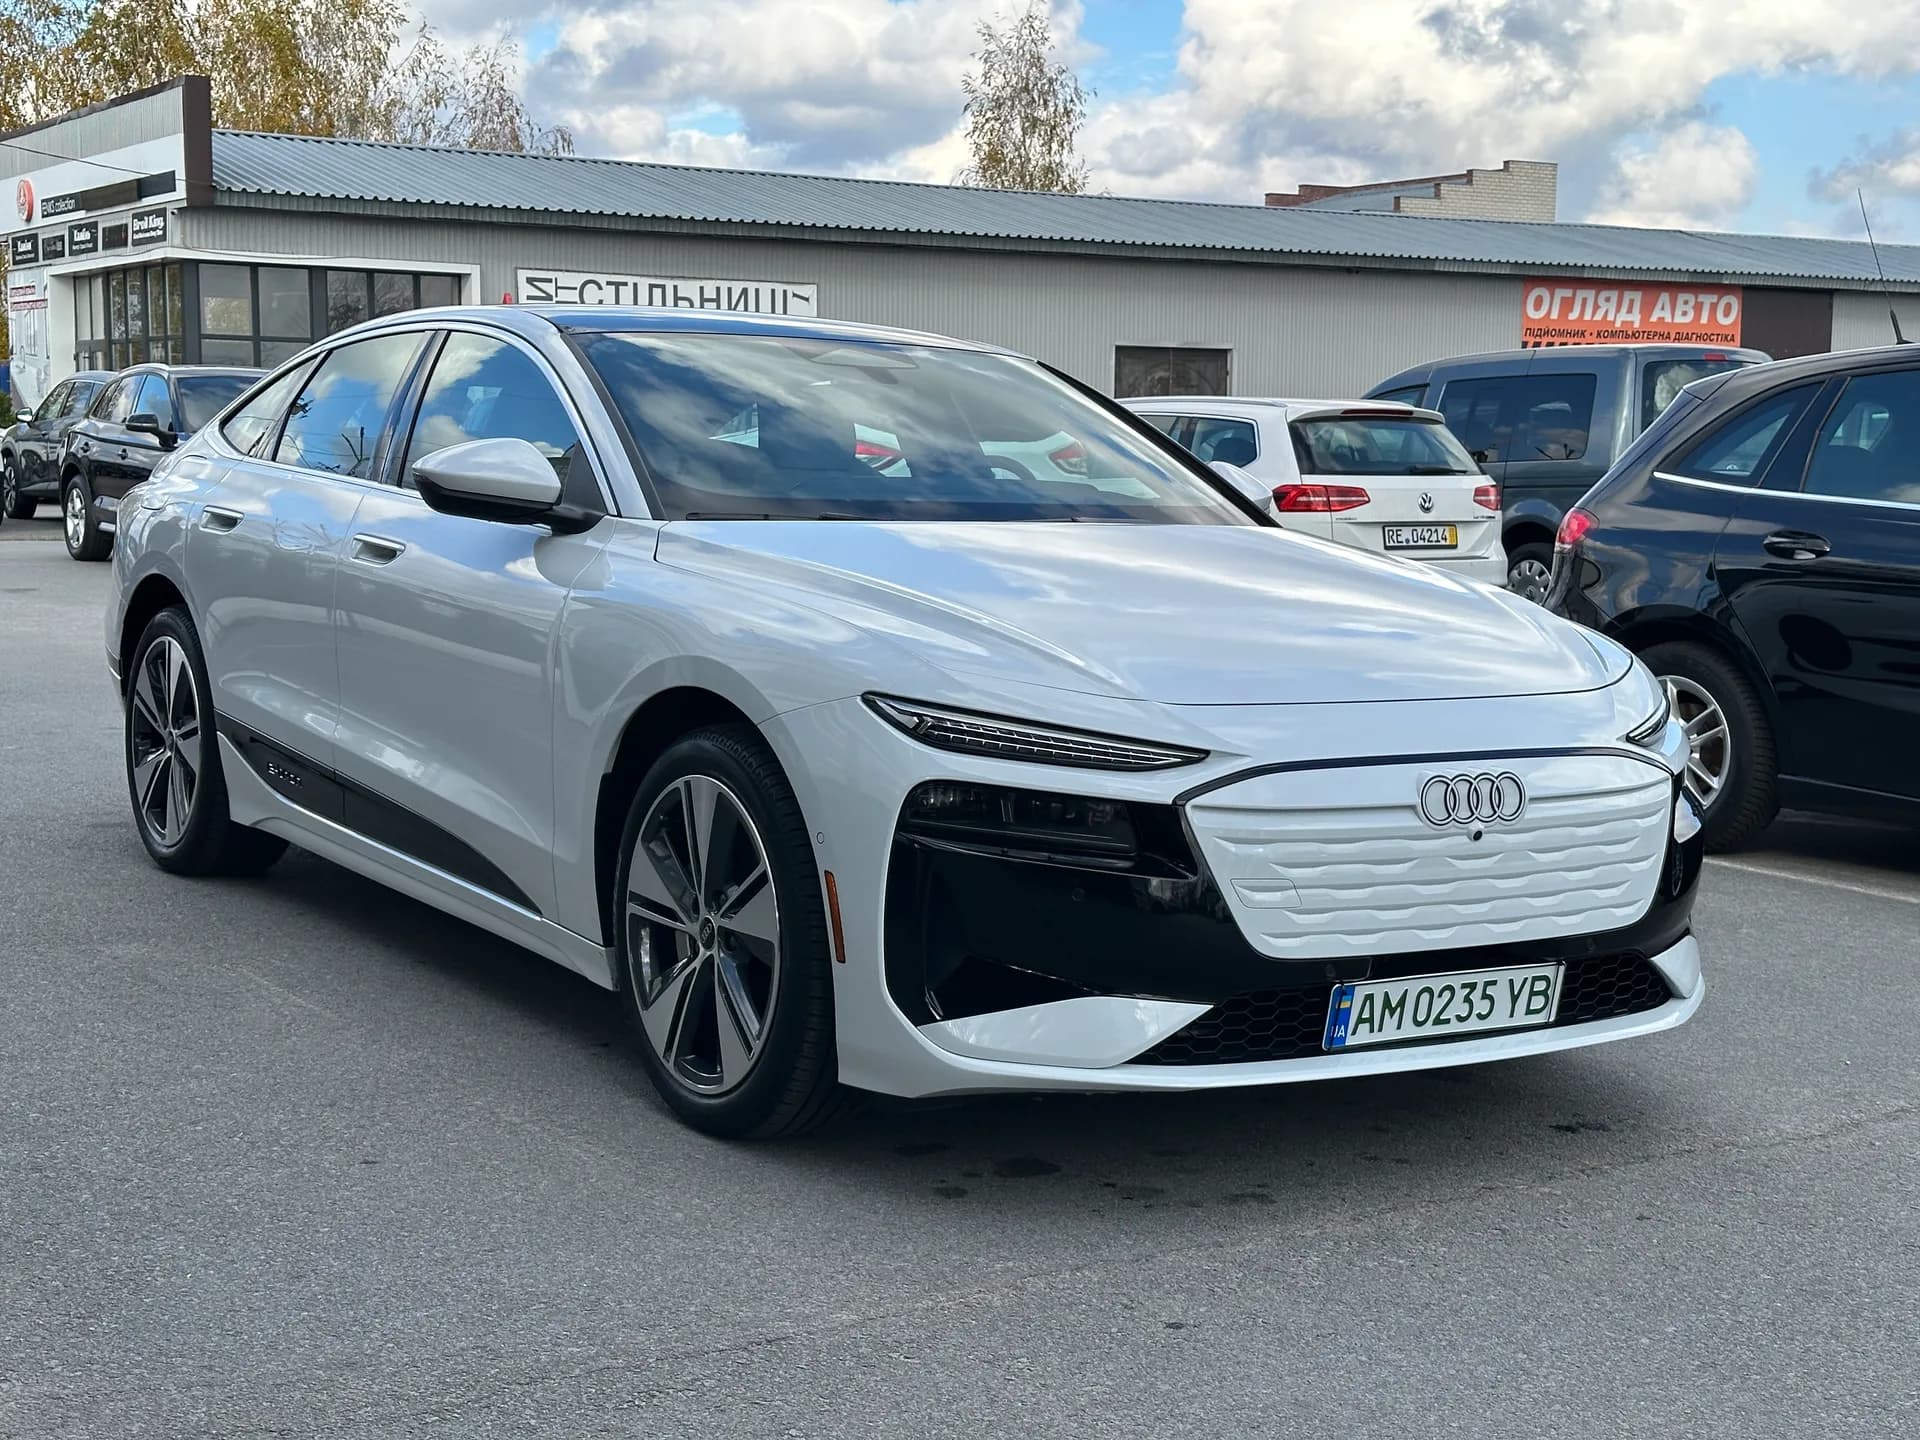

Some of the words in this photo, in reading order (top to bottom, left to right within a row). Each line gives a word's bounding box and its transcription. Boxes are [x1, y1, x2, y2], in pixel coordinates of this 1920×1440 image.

[1525, 286, 1642, 328] ОГЛЯД
[1649, 291, 1739, 326] АВТО
[1524, 326, 1587, 340] ПІДЙОМНИК
[1350, 987, 1409, 1036] AM
[1412, 979, 1498, 1028] 0235
[1508, 973, 1551, 1018] YB
